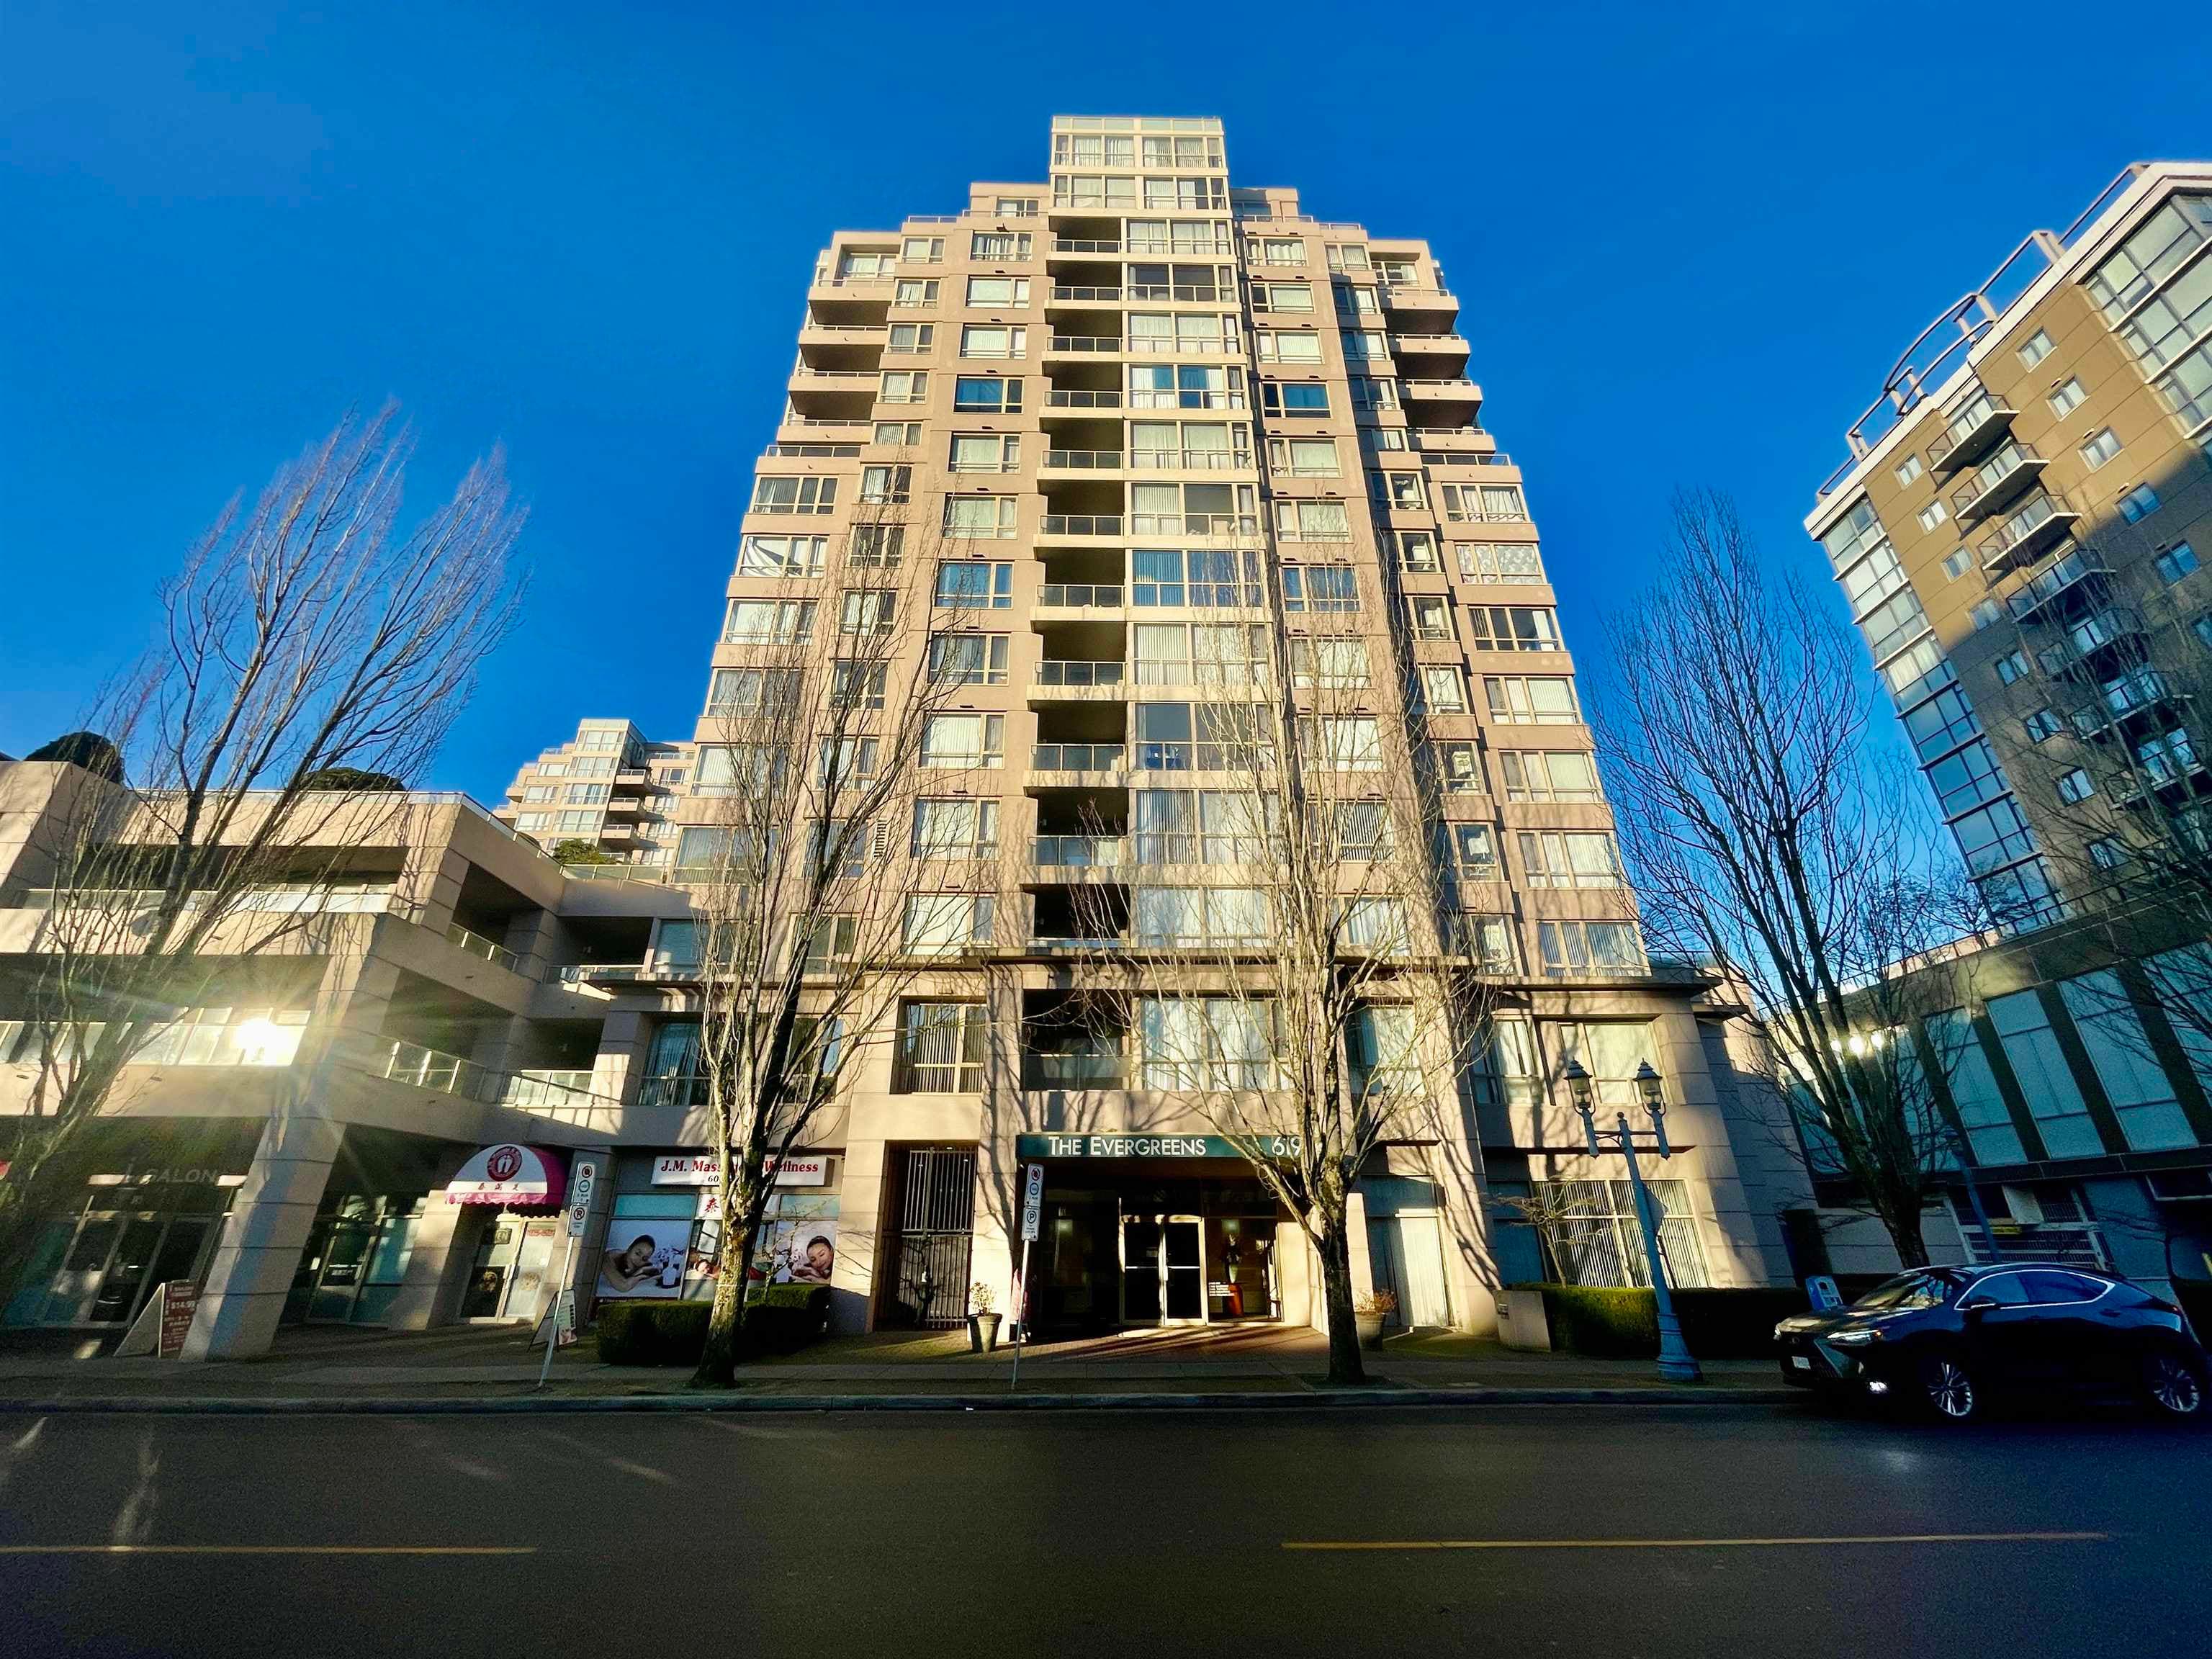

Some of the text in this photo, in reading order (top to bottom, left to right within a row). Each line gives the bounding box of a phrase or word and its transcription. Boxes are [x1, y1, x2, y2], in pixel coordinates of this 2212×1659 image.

[1048, 1136, 1207, 1156] THE EVERGREENS
[1272, 1136, 1302, 1156] 619
[660, 1159, 688, 1172] J.M.
